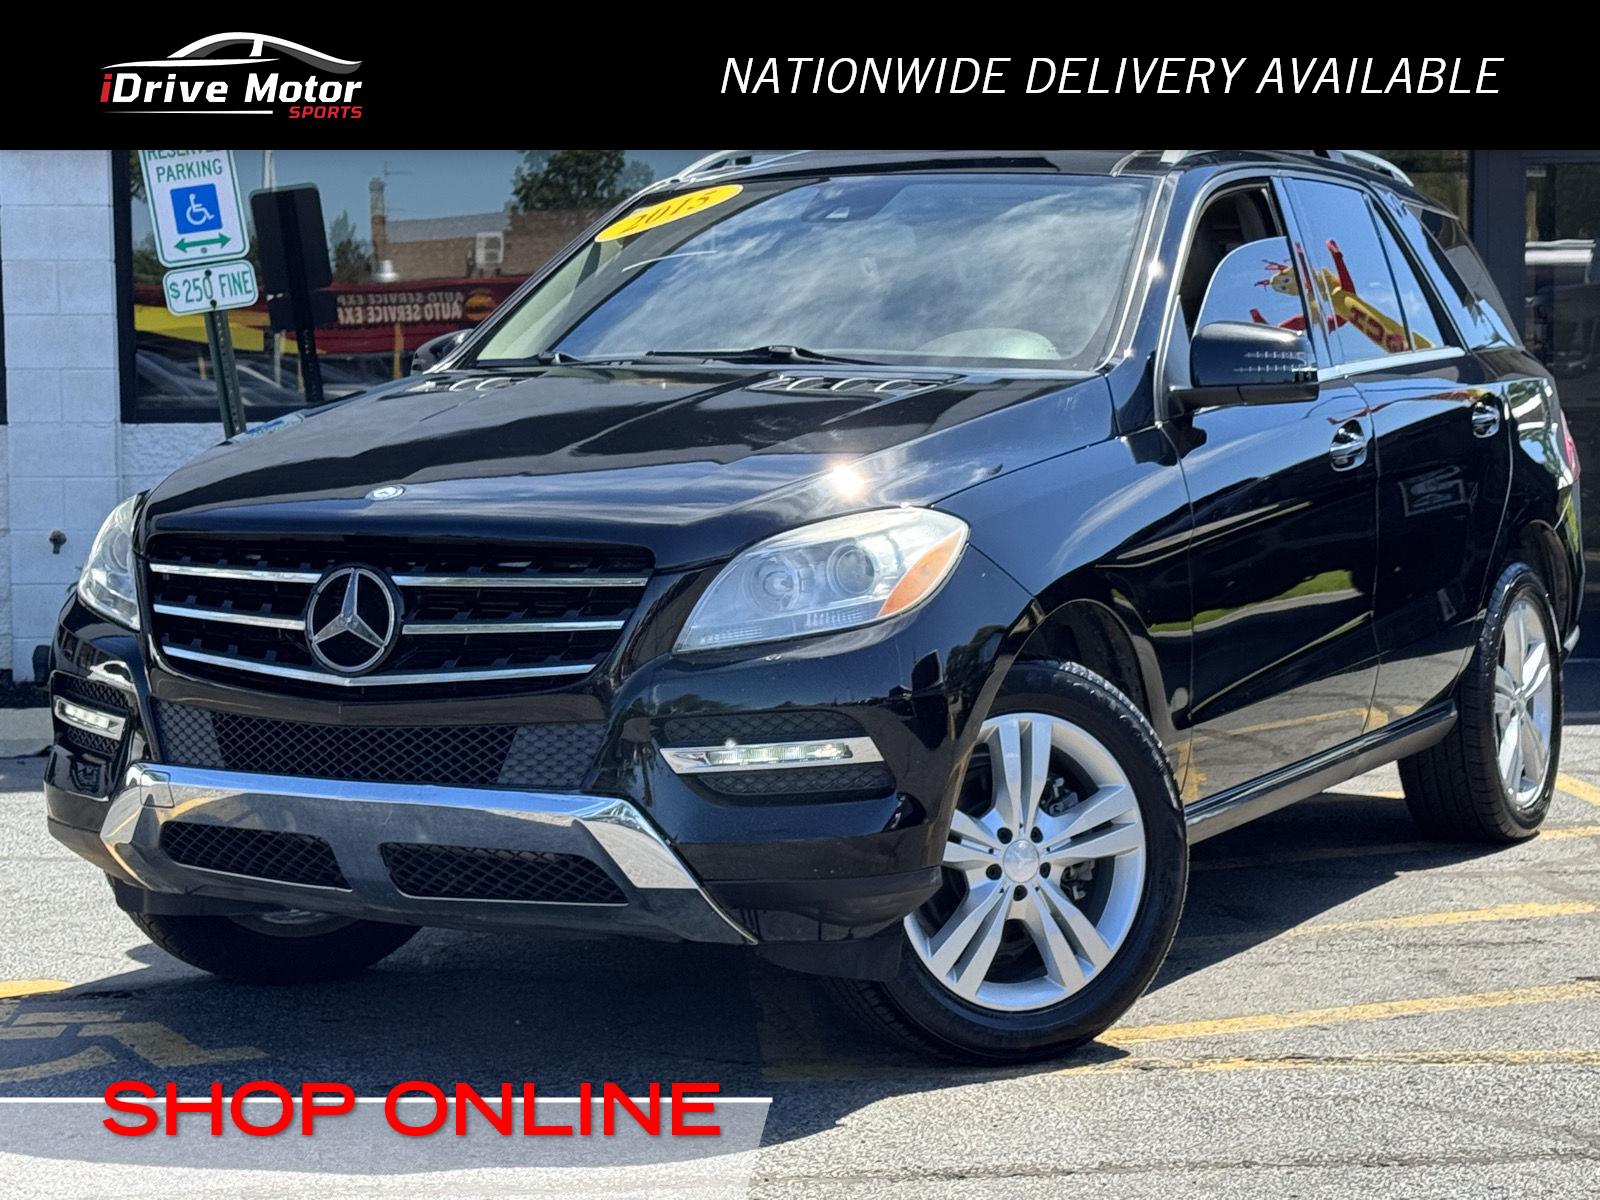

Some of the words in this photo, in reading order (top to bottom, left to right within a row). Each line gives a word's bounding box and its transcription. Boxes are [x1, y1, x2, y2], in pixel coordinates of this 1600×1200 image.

[156, 158, 223, 183] PARKING
[619, 190, 718, 234] 2015
[169, 276, 214, 303] $250
[219, 271, 253, 298] FINE
